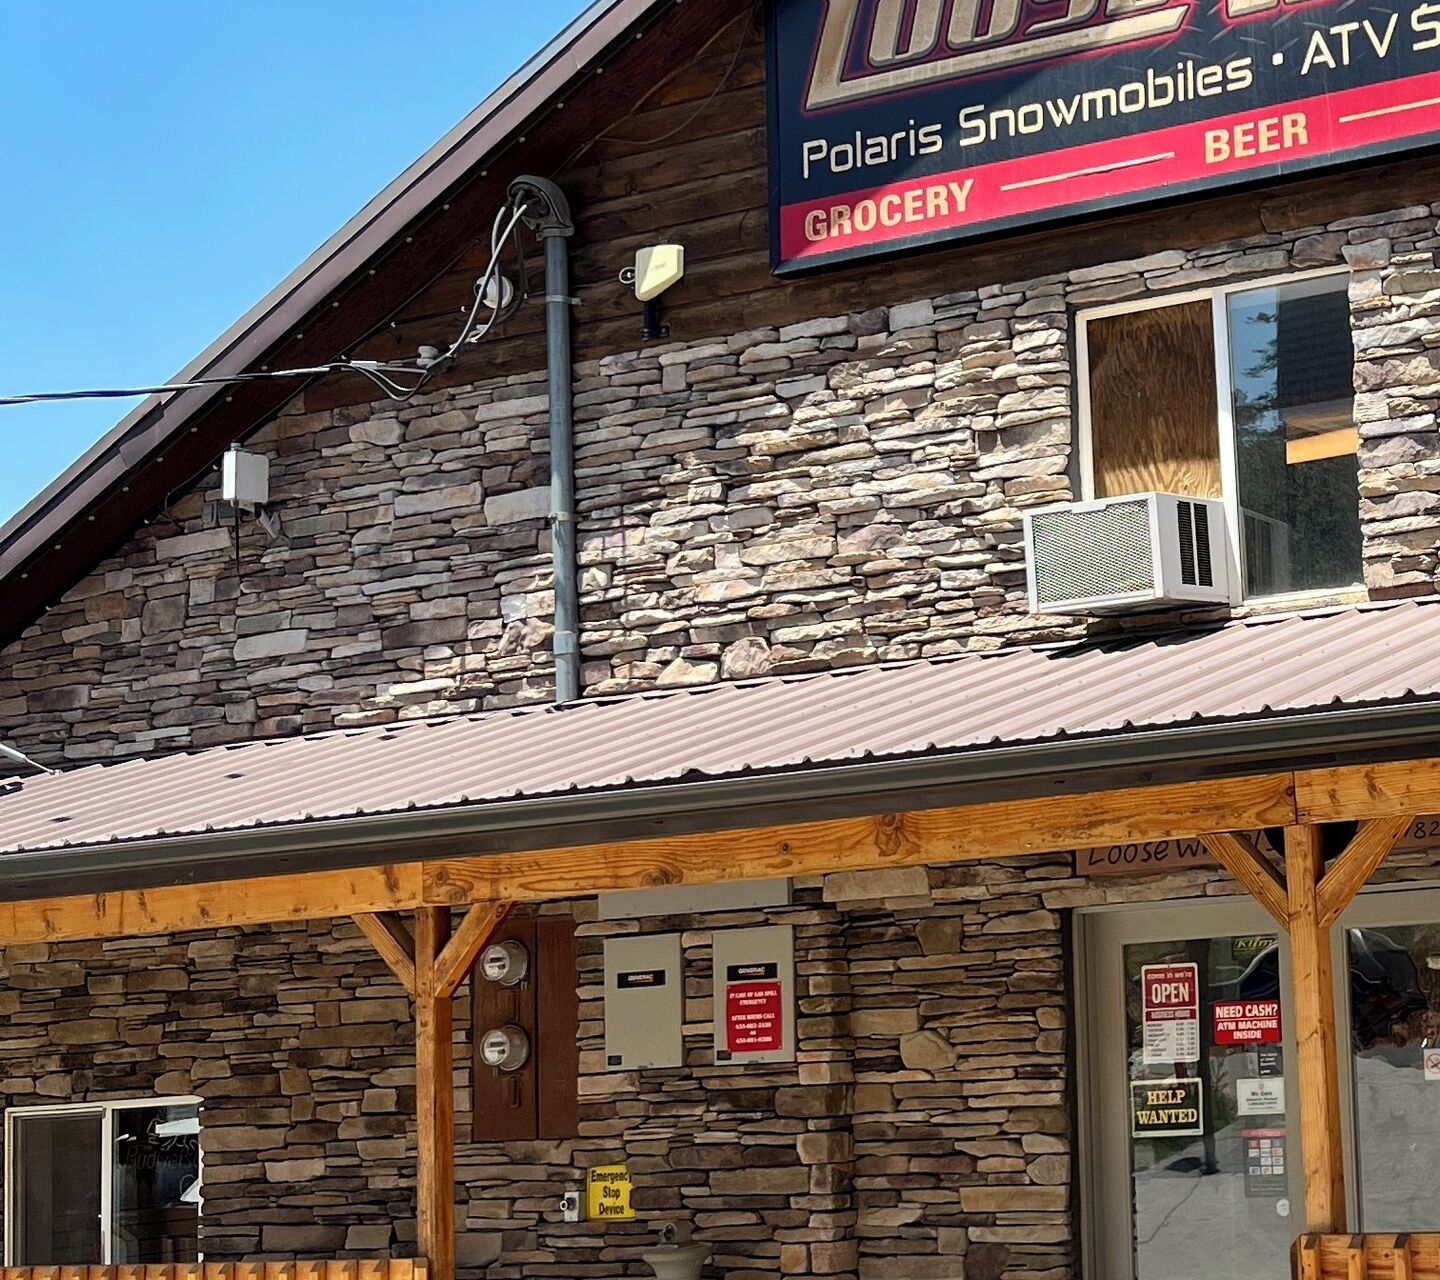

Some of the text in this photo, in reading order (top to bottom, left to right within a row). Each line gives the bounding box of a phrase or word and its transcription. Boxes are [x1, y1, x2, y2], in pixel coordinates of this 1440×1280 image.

[803, 120, 942, 178] Polaris
[959, 57, 1253, 148] Snowmobiles
[804, 180, 975, 242] GROCERY
[1205, 113, 1309, 164] BEER
[1152, 983, 1189, 1004] OPEN
[1215, 1004, 1278, 1019] NEED CASH?
[1217, 1020, 1278, 1030] ATM MACHINE
[1233, 1030, 1262, 1039] INSIDE
[1147, 1090, 1186, 1105] HELP
[1136, 1108, 1198, 1125] WANTED
[602, 1185, 621, 1199] Stop
[598, 1201, 625, 1216] Device
